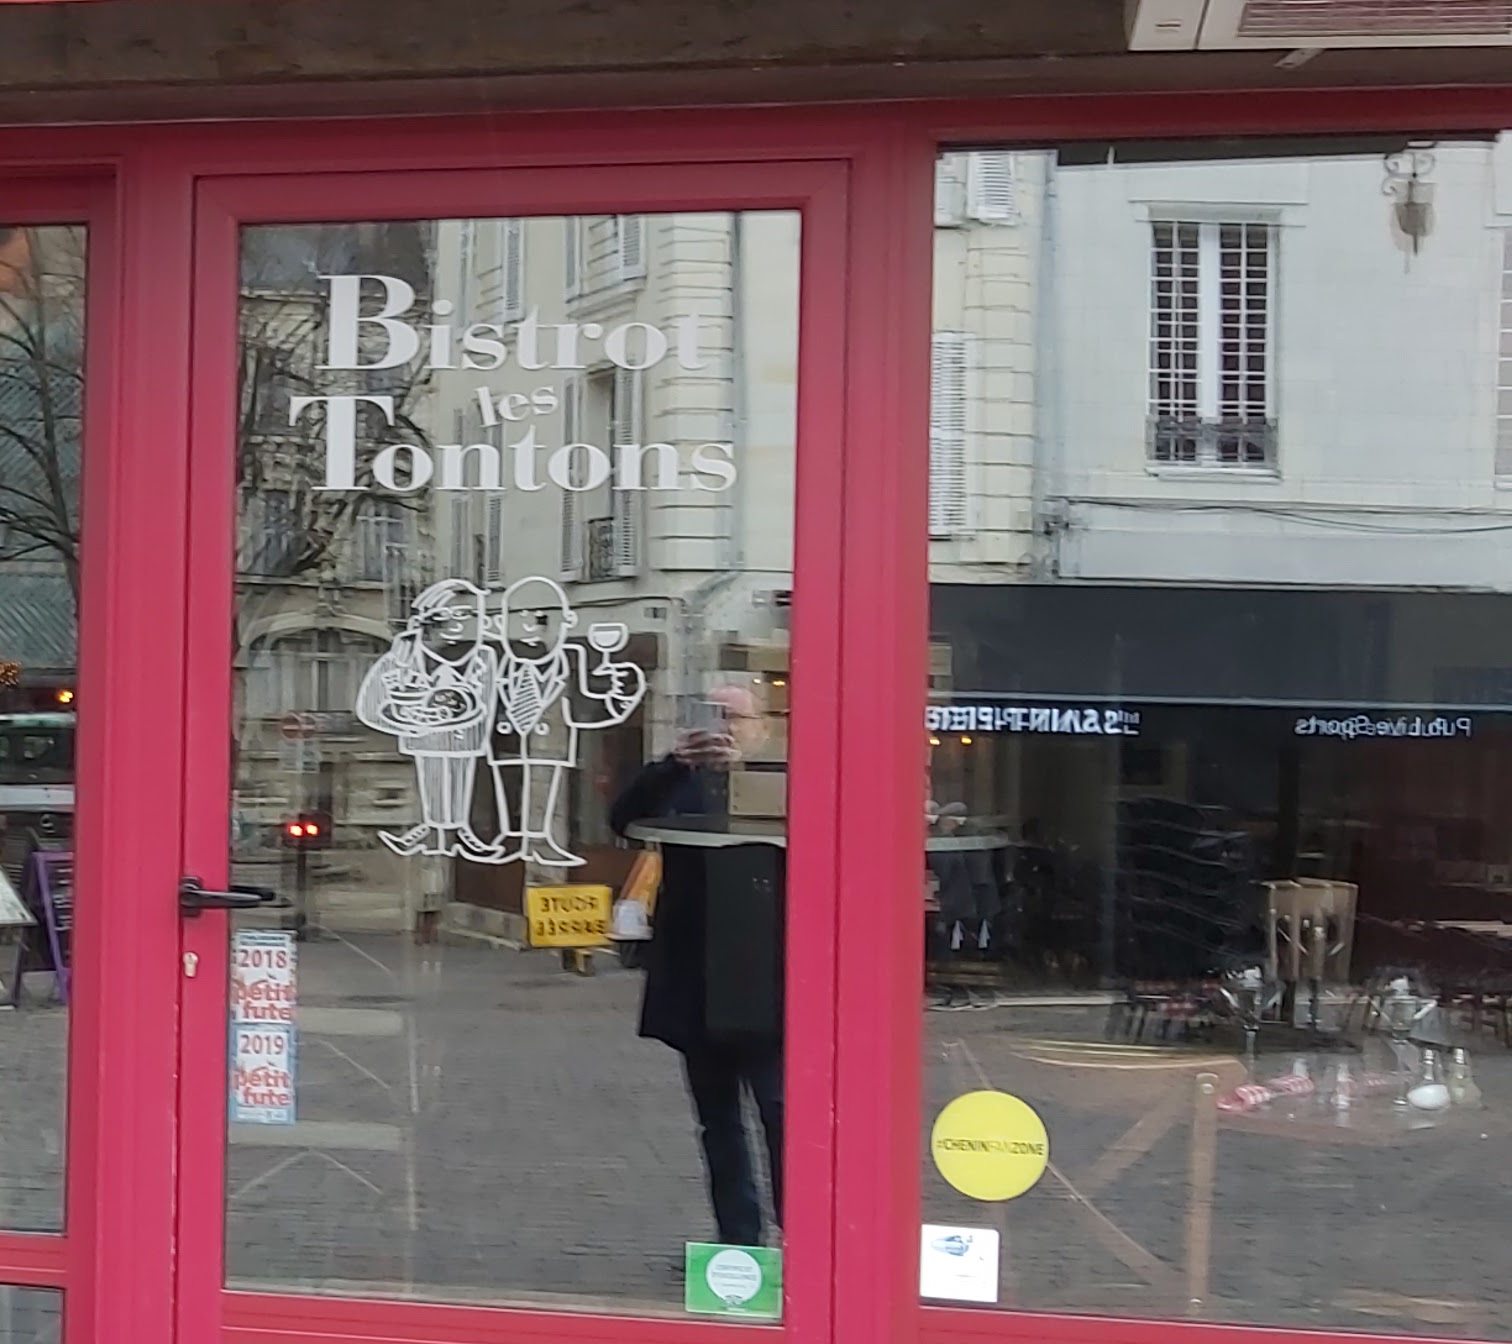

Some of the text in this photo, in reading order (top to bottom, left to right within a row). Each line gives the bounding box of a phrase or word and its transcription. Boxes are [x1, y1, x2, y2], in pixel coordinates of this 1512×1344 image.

[316, 272, 707, 372] Bistrot
[473, 380, 559, 428] les
[289, 394, 739, 494] Tontons
[240, 950, 288, 969] 2018
[240, 1034, 285, 1055] 2019
